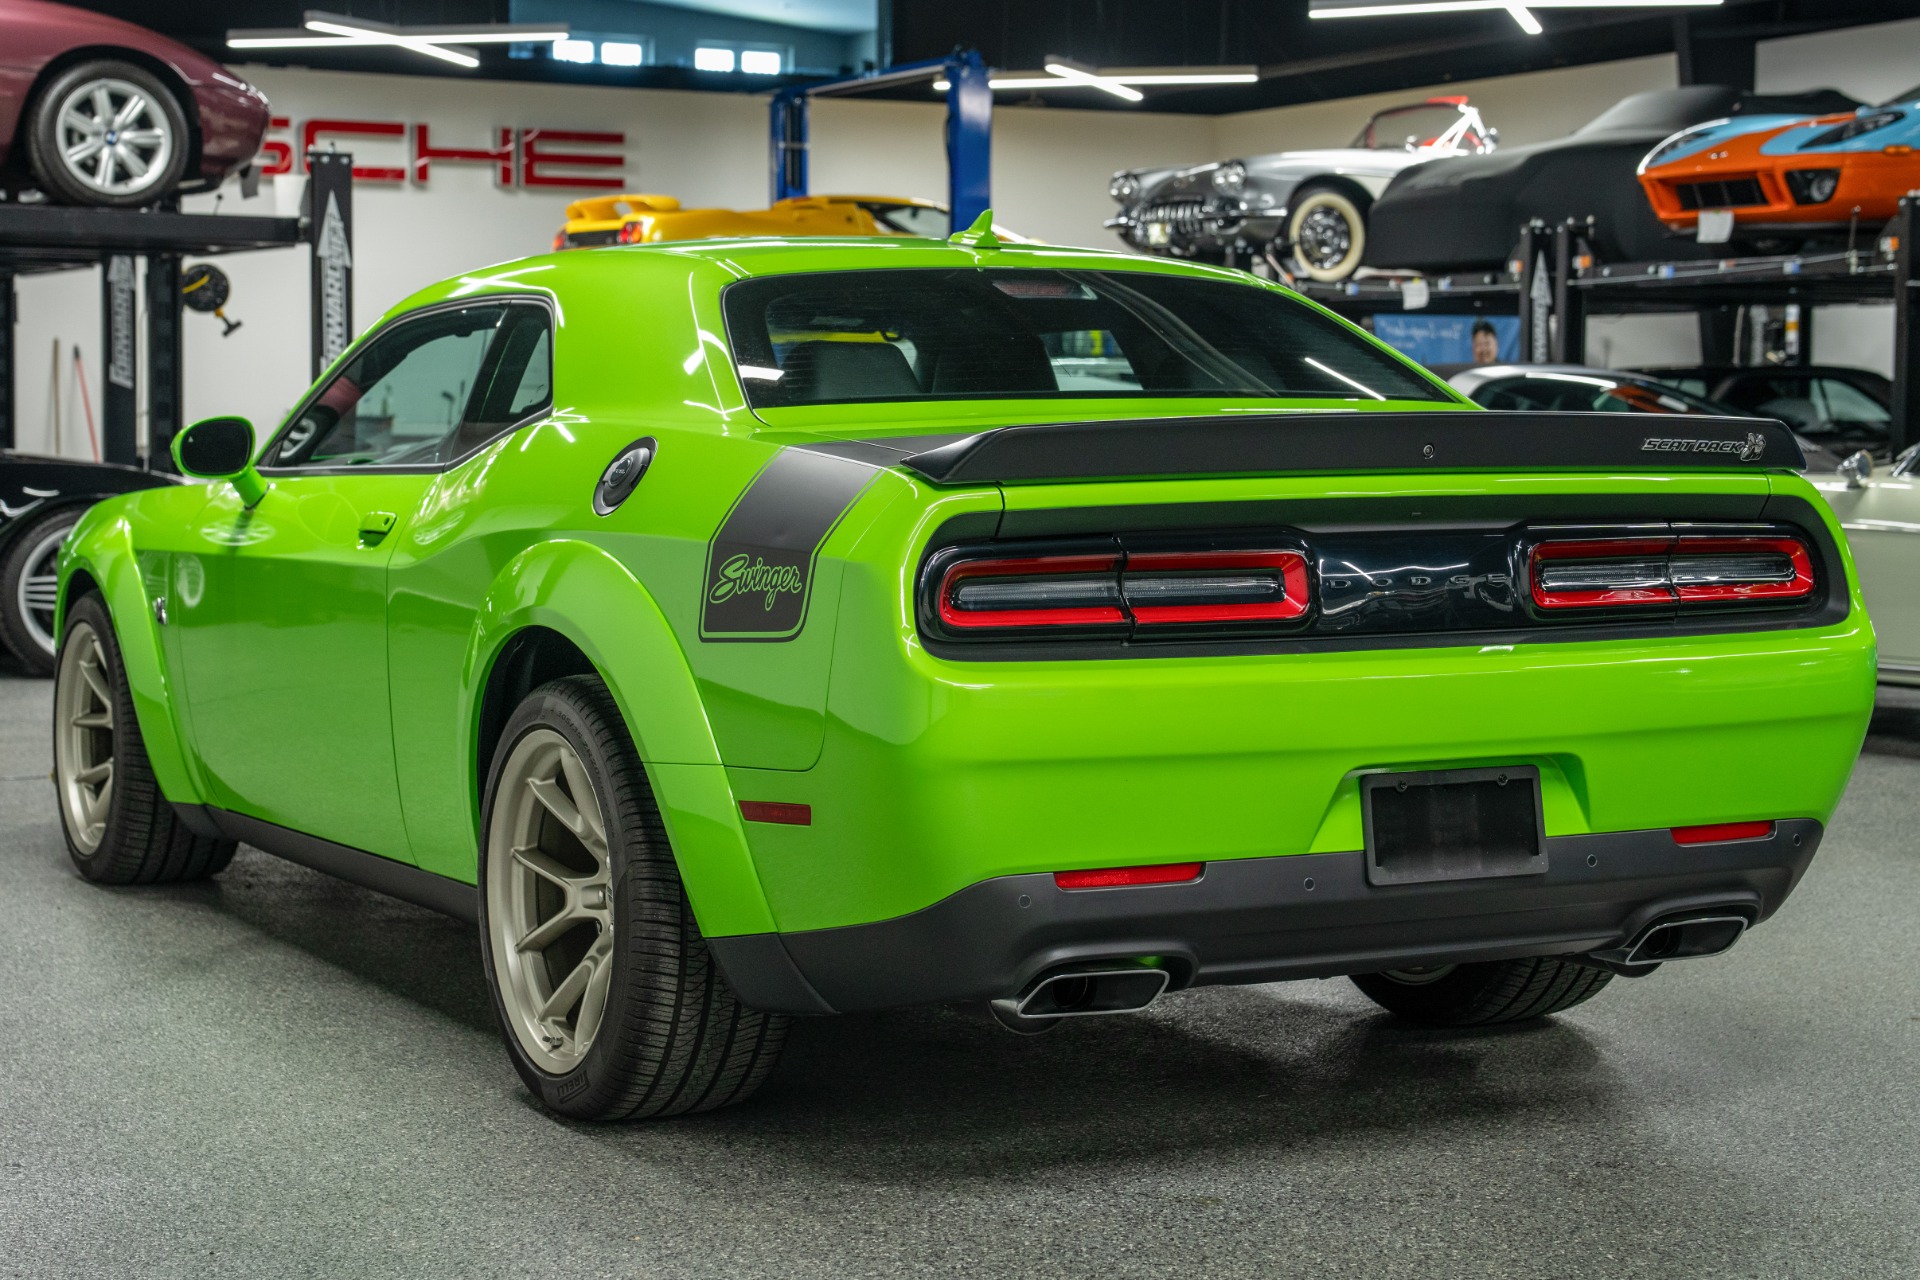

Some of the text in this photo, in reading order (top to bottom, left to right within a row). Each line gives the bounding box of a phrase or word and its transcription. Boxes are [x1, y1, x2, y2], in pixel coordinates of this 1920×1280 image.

[1641, 438, 1744, 453] SCAT PACK
[709, 553, 803, 611] Swinger
[1330, 574, 1508, 589] DODGE
[556, 1070, 590, 1105] PIRELLI
